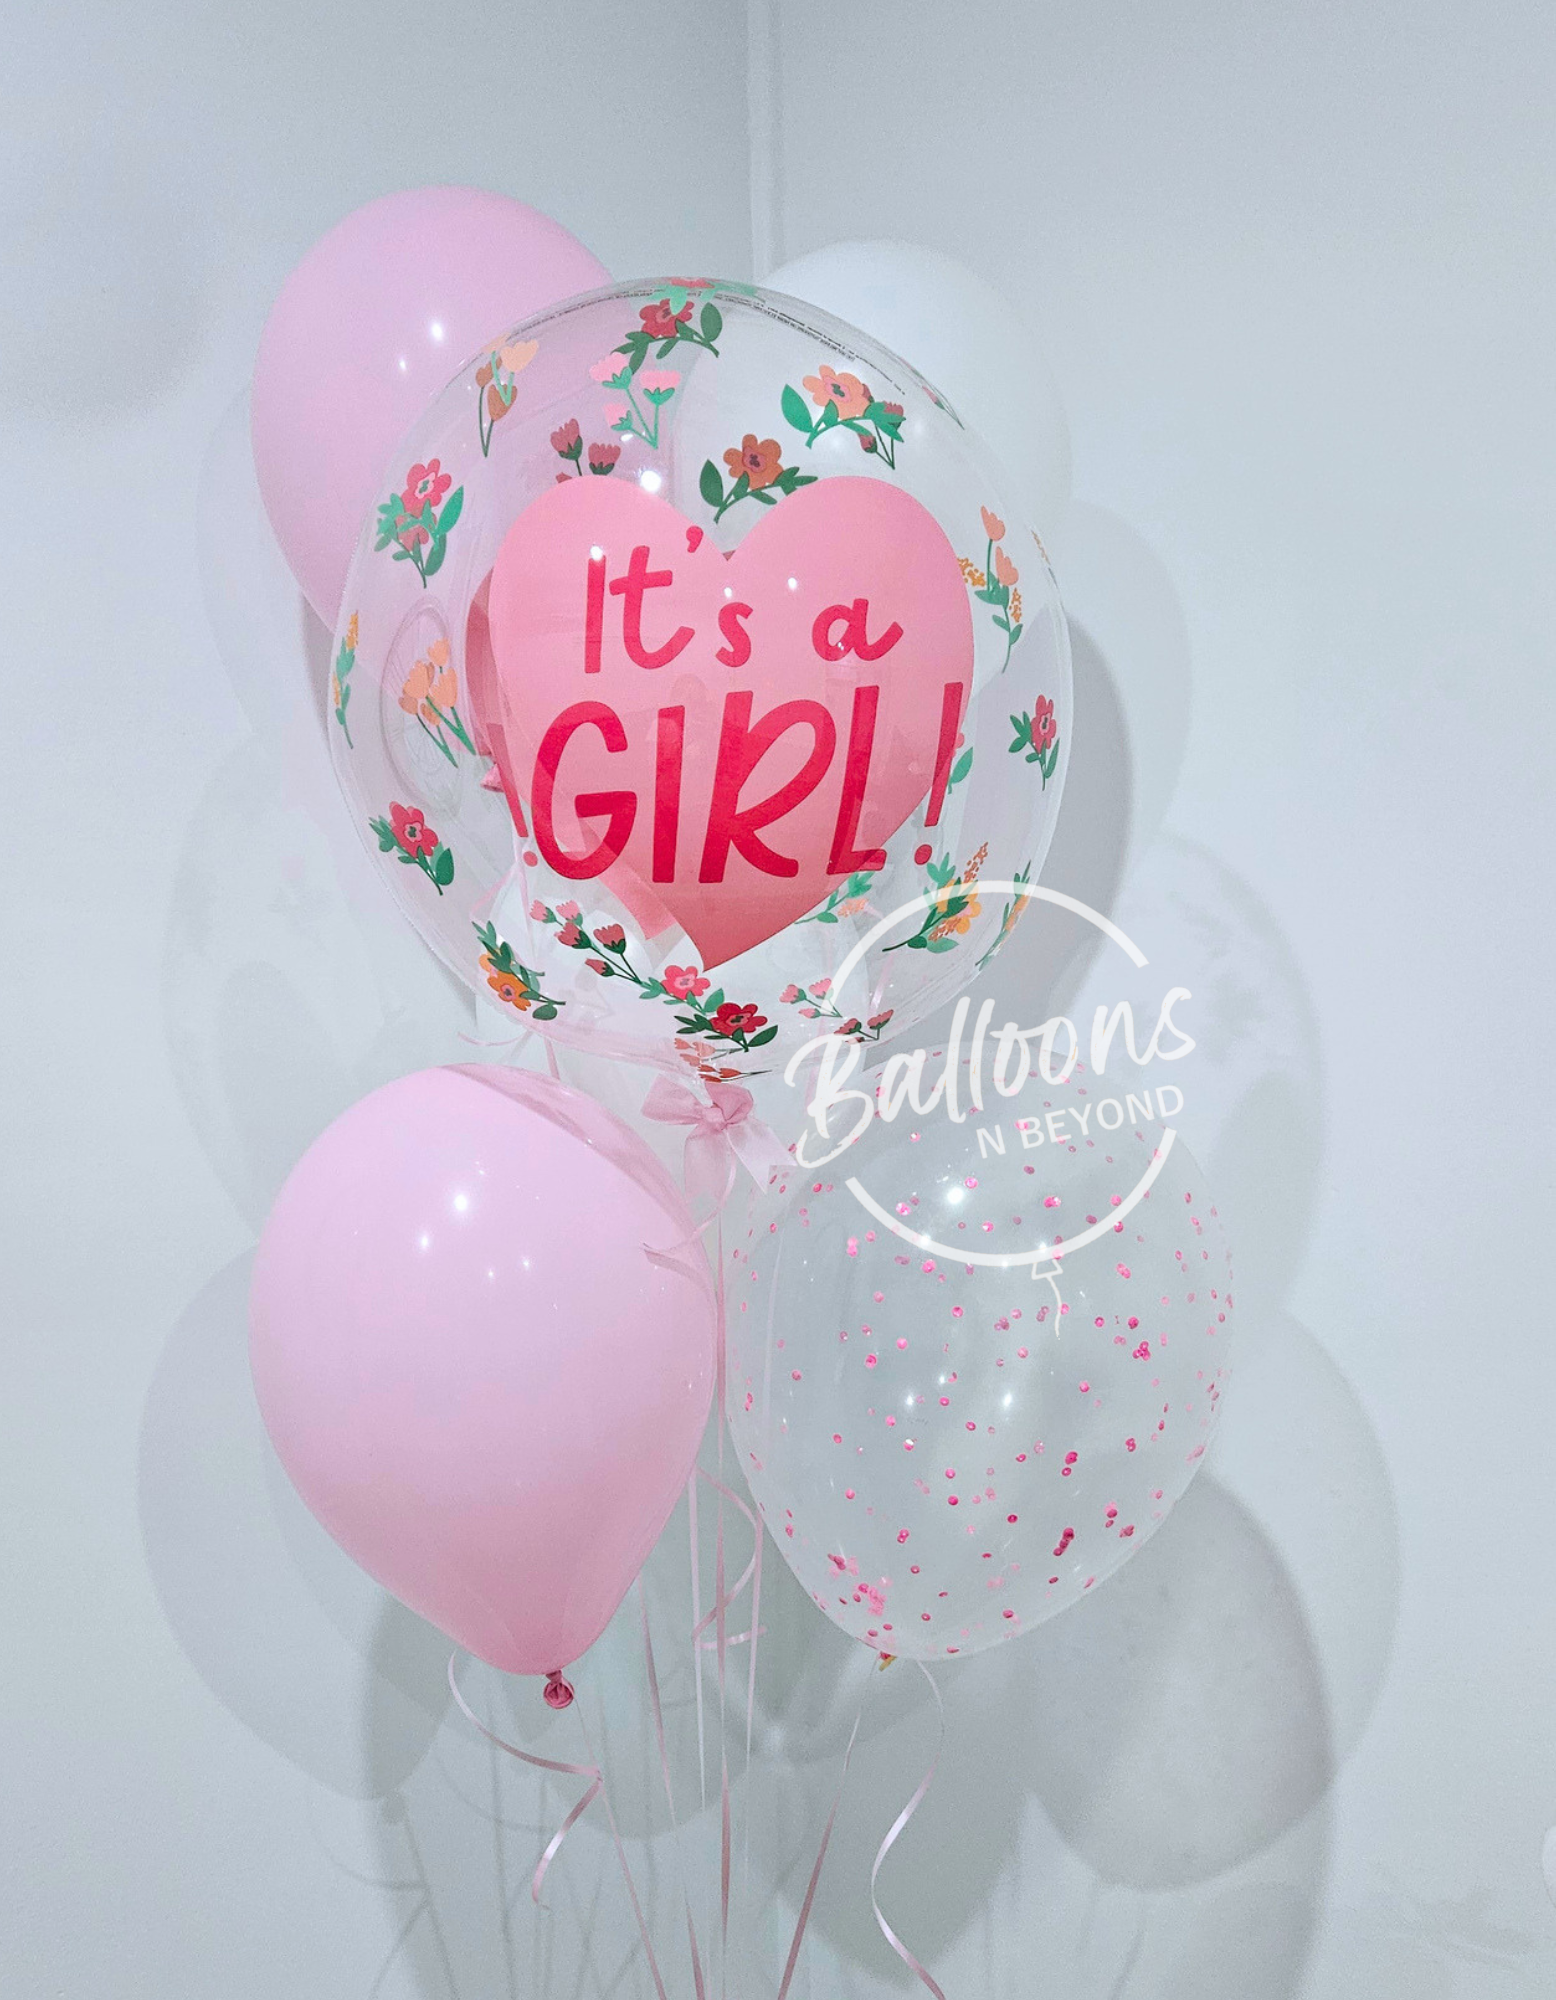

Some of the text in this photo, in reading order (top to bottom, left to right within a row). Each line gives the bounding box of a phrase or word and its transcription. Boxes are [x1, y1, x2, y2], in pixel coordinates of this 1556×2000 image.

[584, 525, 904, 674] It's a
[531, 682, 964, 884] GIRL!
